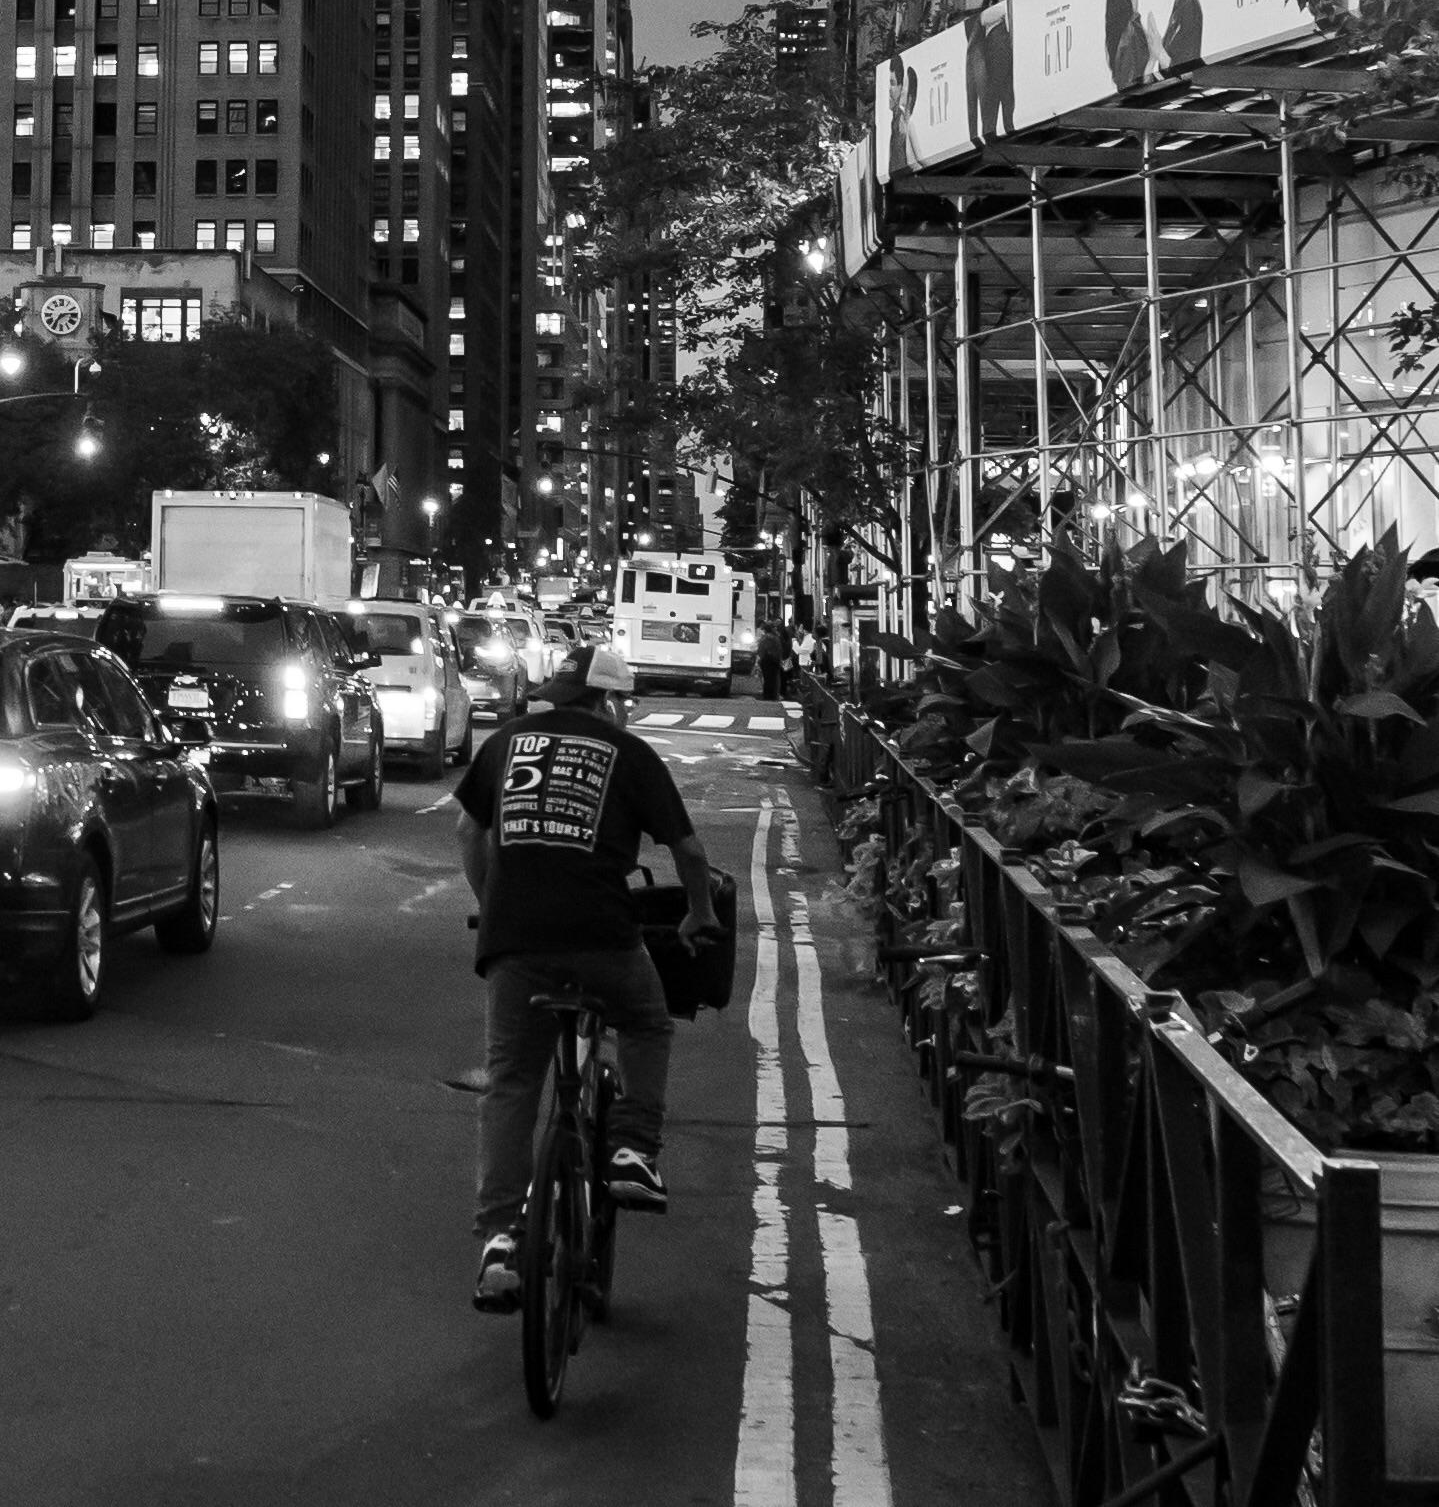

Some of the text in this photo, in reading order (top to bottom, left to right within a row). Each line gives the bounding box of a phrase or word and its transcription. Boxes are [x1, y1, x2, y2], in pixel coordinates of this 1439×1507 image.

[1044, 25, 1072, 77] GAP
[515, 736, 550, 753] TOP
[504, 755, 544, 791] 5
